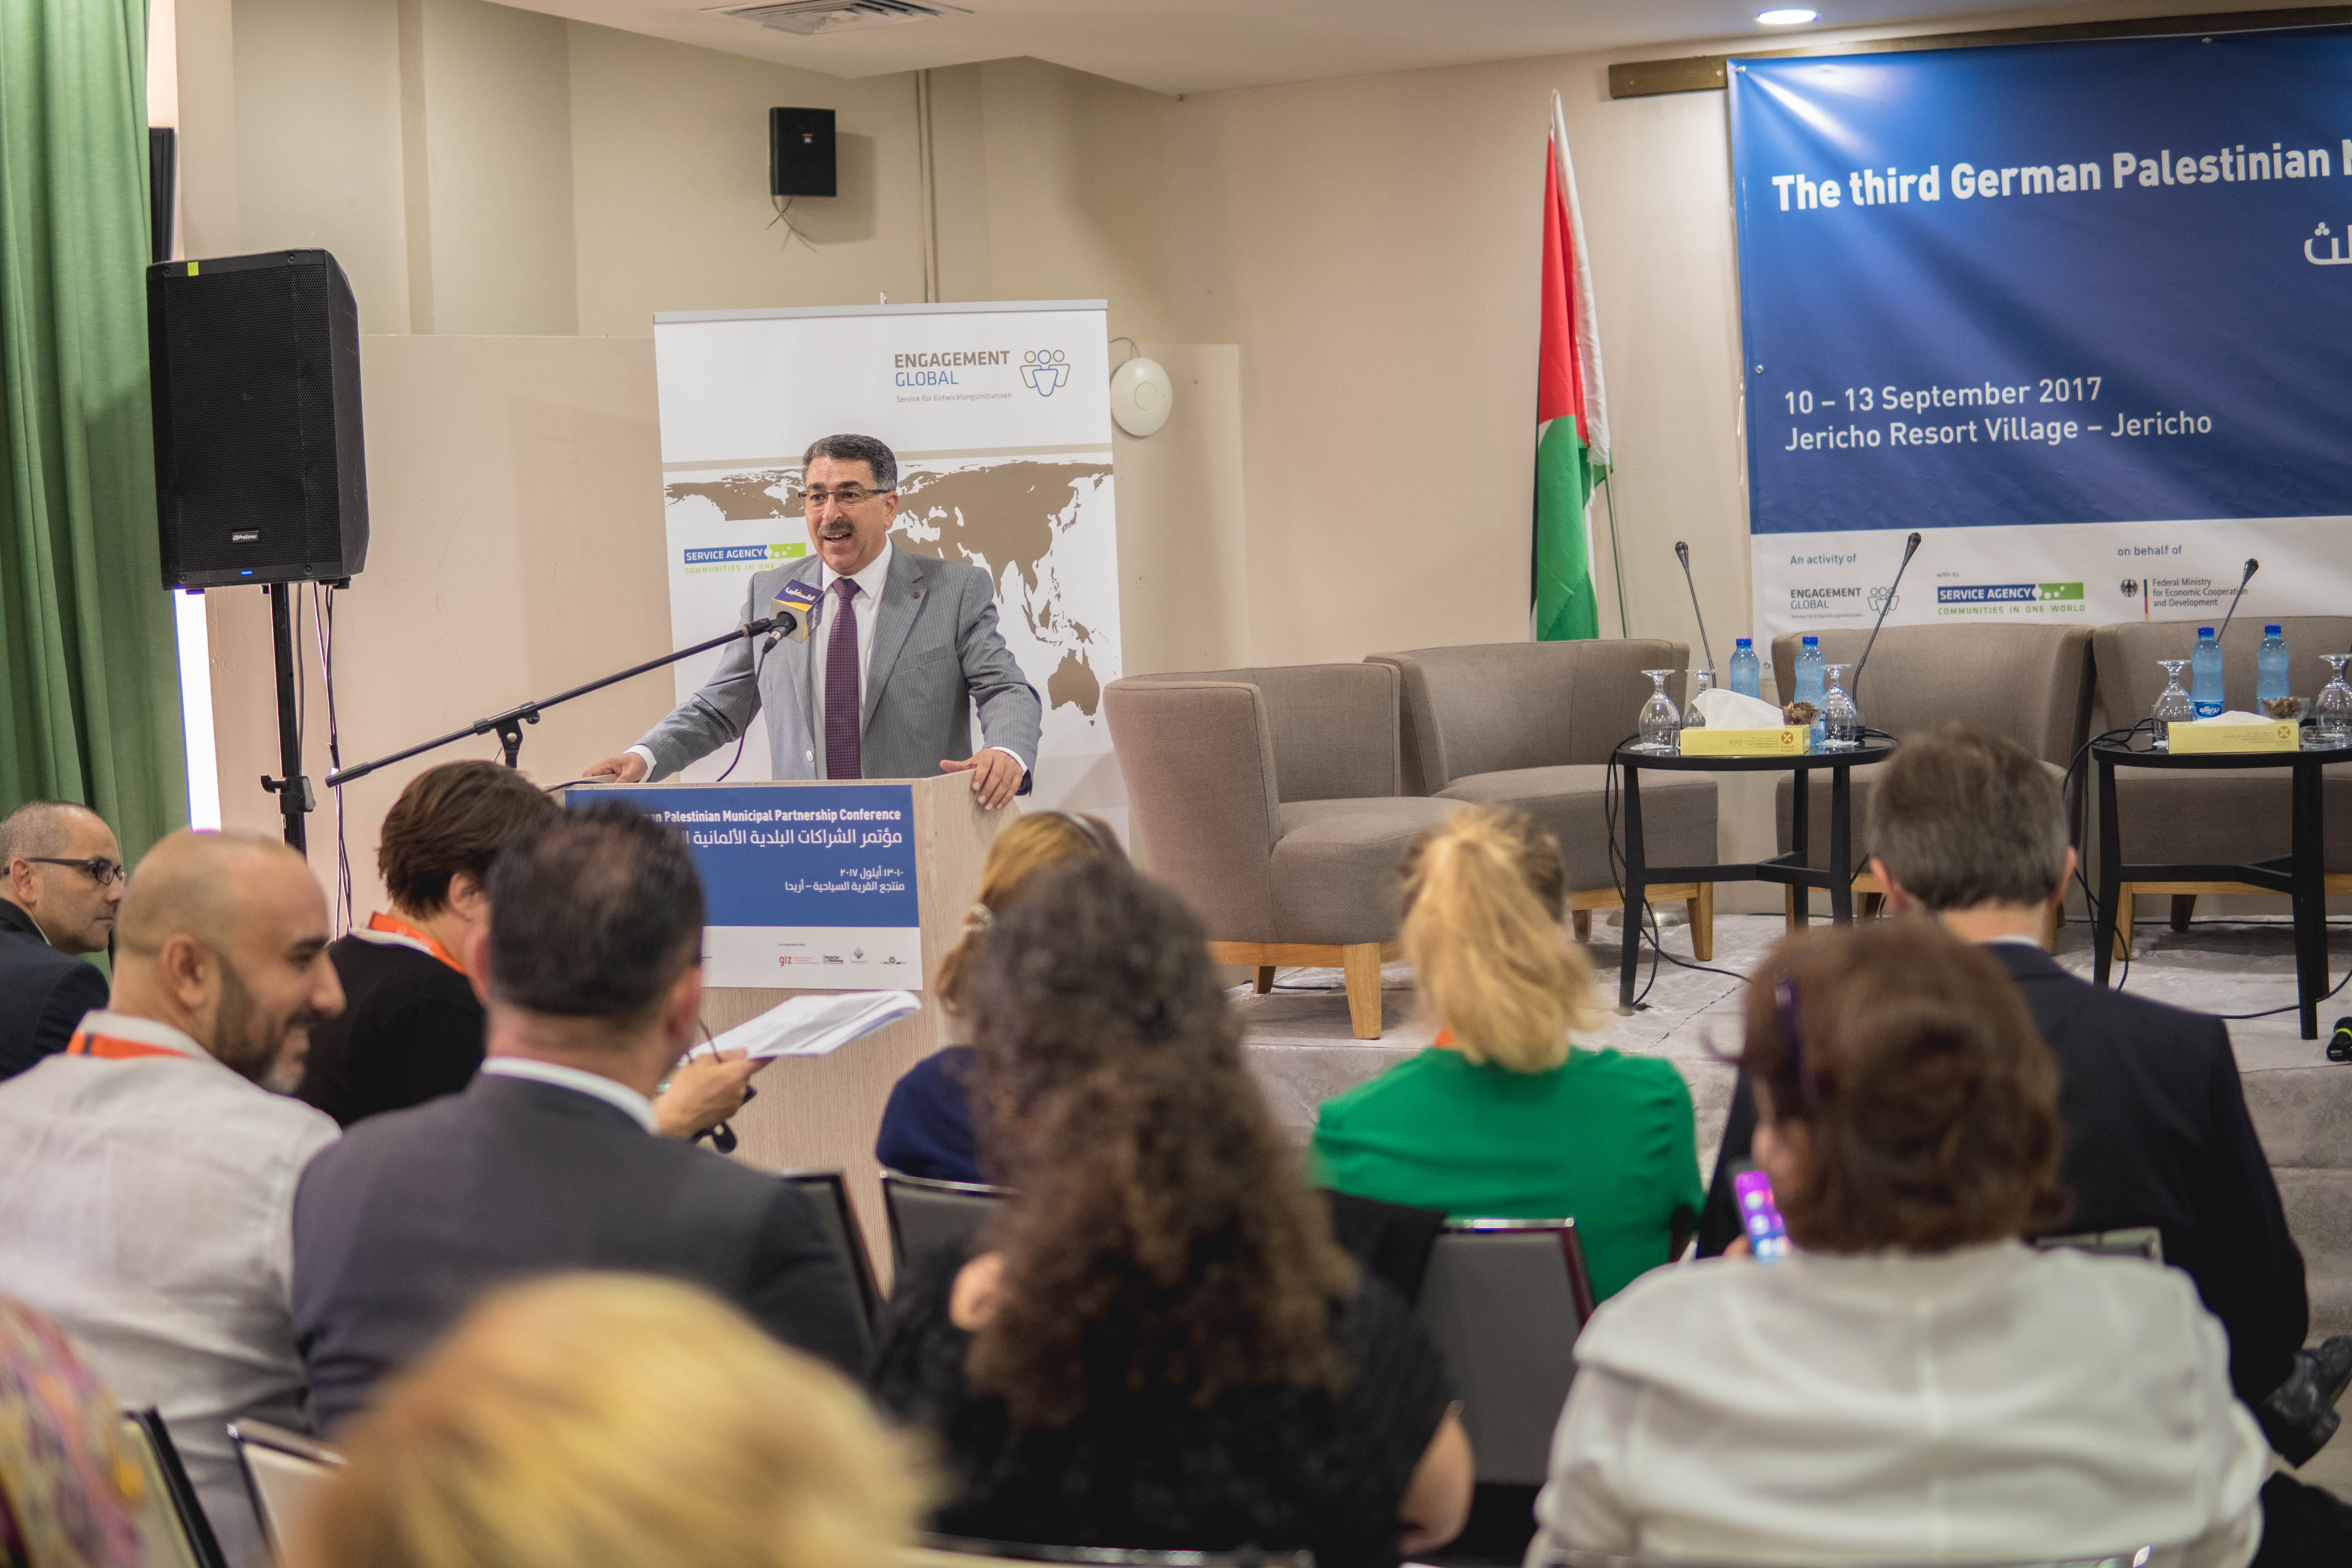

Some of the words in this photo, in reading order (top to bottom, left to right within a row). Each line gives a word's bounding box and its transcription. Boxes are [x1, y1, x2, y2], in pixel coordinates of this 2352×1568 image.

[1772, 174, 1840, 211] The
[1849, 165, 1940, 205] third
[1951, 163, 2100, 199] German
[2113, 143, 2330, 189] Palestinian
[895, 351, 1010, 368] ENGAGEMENT
[896, 371, 958, 386] GLOBAL
[934, 393, 1011, 401] Entwicklungsinitiativen
[1786, 391, 1813, 414] 10
[1846, 387, 1873, 411] 13
[1882, 381, 2031, 414] September
[2040, 377, 2101, 403] 2017
[1785, 425, 1880, 450] Jericho
[1890, 421, 1977, 446] Resort
[1985, 417, 2078, 445] Village
[2111, 411, 2211, 437] Jericho
[686, 552, 724, 561] SERVICE
[726, 548, 763, 559] AGENCY
[2134, 545, 2168, 555] behalf
[2172, 545, 2181, 554] of
[1791, 555, 1803, 564] An
[1807, 554, 1843, 565] activity
[1847, 554, 1856, 563] of
[685, 564, 740, 573] COMMUNITIES
[2181, 578, 2211, 587] Ministry
[1791, 588, 1861, 598] ENGAGEMENT
[1940, 589, 1984, 602] SERVICE
[1987, 588, 2031, 599] AGENCY
[1791, 600, 1829, 609] GLOBAL
[2169, 599, 2218, 607] Development
[1938, 606, 2003, 615] COMMUNITIES
[664, 811, 720, 822] Palestinian
[723, 810, 773, 824] Municipal
[775, 809, 837, 823] Partnership
[840, 809, 901, 820] Conference
[693, 829, 746, 848] الألمانية
[750, 829, 794, 847] البلدية
[798, 828, 856, 848] الشراكات
[860, 828, 902, 848] مؤتمر
[860, 866, 882, 880] أيلول
[785, 879, 804, 893] أريحا
[813, 882, 849, 892] السياحية
[851, 879, 877, 893] القرية
[880, 882, 904, 893] منتجع
[779, 955, 793, 966] giz
